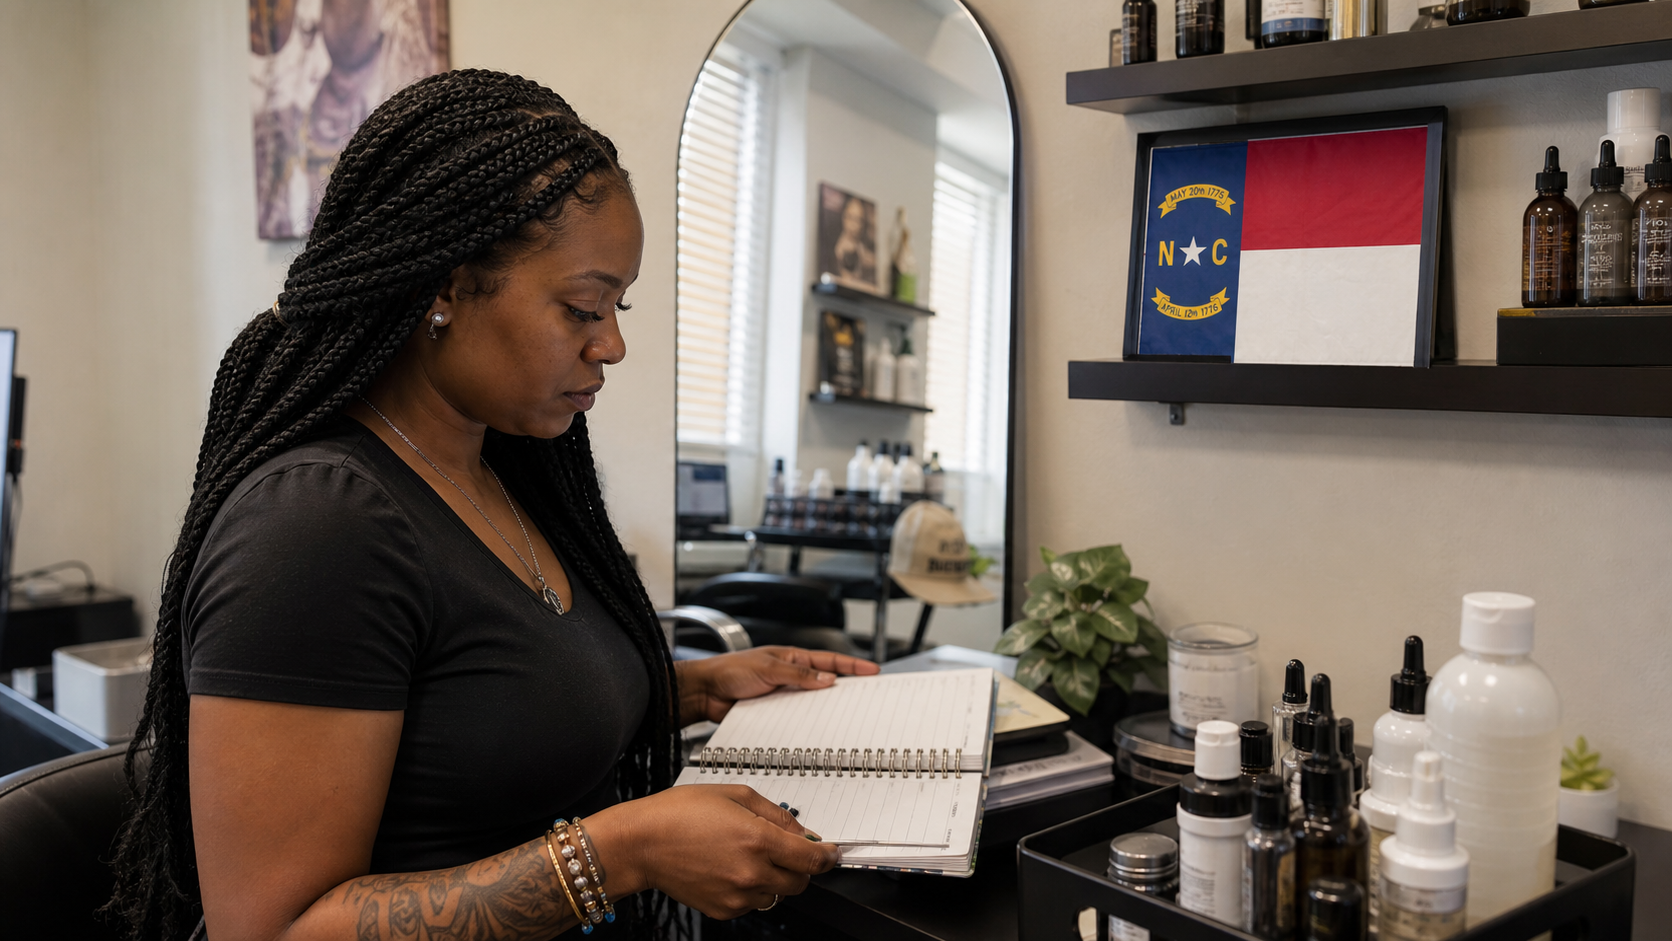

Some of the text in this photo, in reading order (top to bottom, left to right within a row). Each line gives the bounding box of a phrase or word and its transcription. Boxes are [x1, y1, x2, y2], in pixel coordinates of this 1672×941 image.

[1170, 188, 1187, 202] MAY
[1207, 187, 1225, 199] 1775
[1158, 238, 1228, 266] N C
[1161, 303, 1182, 317] APRIL
[1200, 303, 1219, 316] 1776
